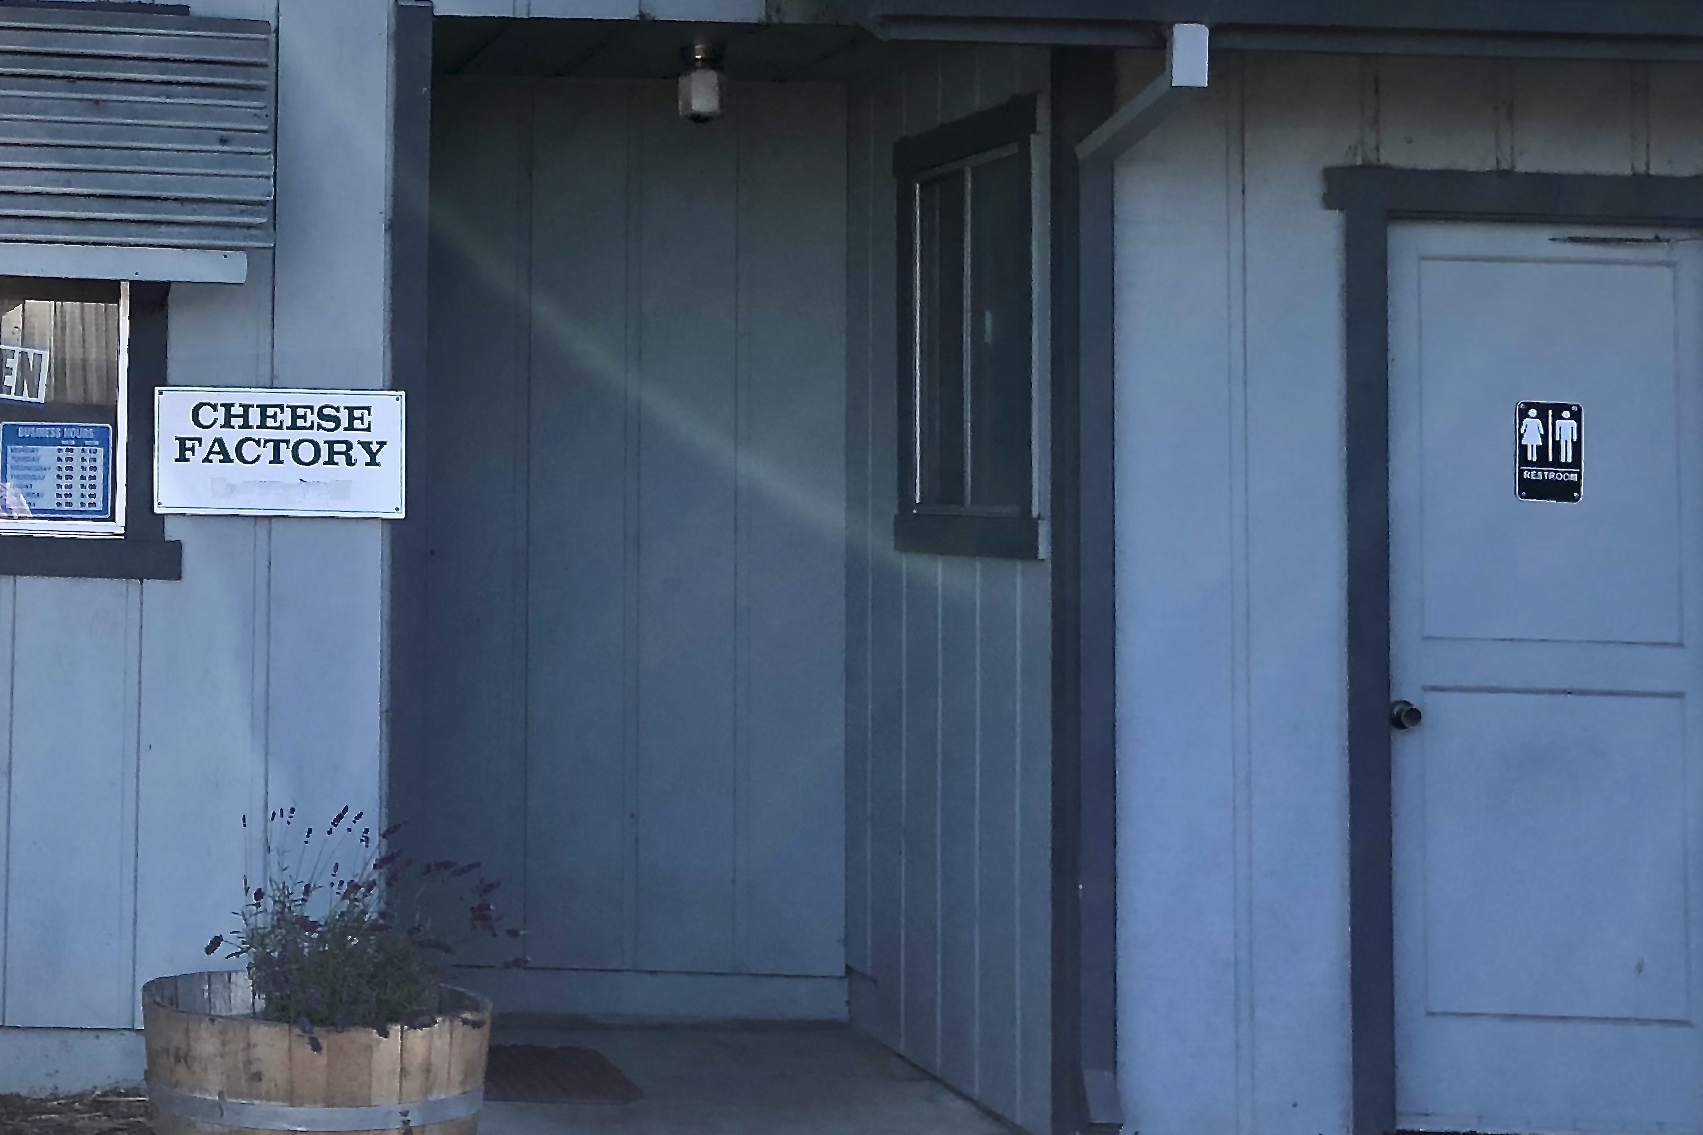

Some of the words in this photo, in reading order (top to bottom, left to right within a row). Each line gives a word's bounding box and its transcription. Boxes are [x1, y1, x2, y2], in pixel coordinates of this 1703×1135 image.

[190, 401, 373, 433] CHEESE
[18, 427, 61, 438] BUSINESS
[64, 428, 94, 439] HOURS
[173, 435, 389, 467] FACTORY
[1523, 470, 1578, 482] RESTROOM
